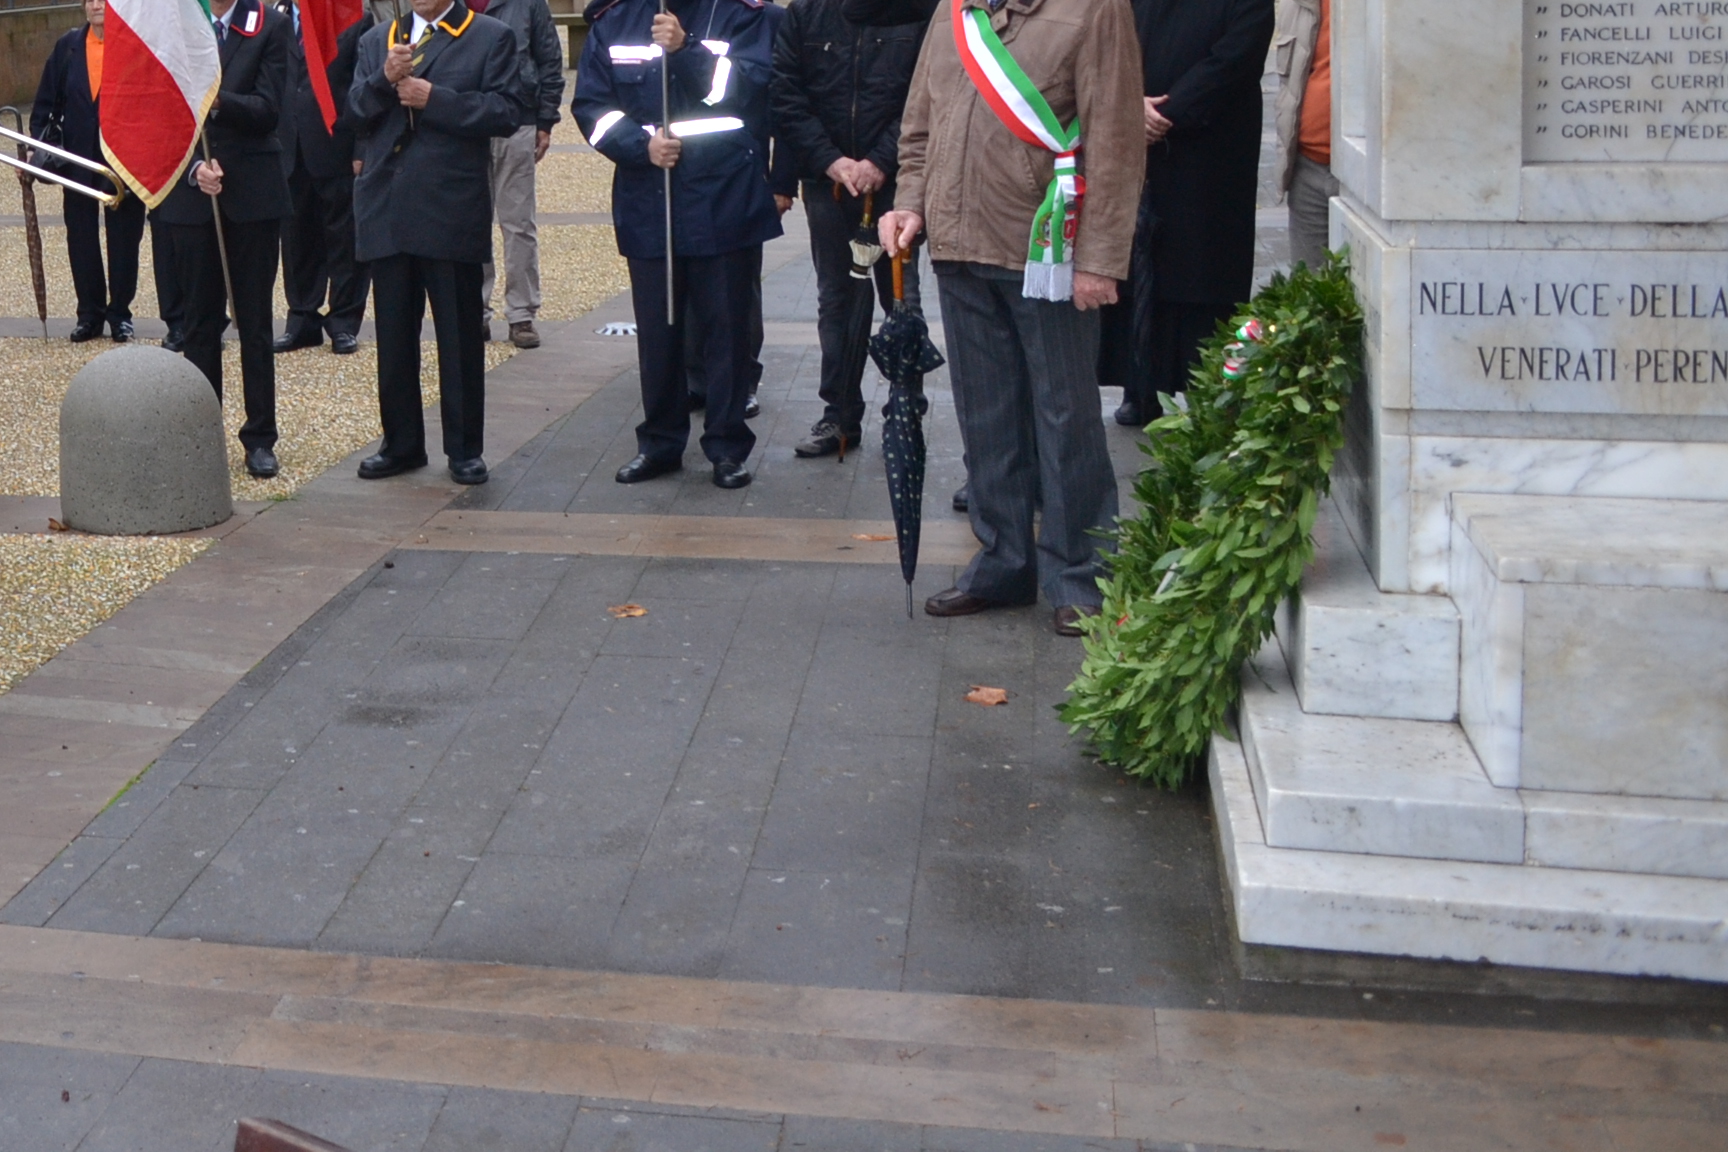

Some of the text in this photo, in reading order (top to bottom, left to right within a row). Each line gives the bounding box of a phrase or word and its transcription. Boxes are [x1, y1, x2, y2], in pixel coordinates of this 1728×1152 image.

[1561, 3, 1634, 18] DONATI
[1561, 27, 1650, 41] FANCELLI
[1669, 26, 1721, 40] LUIGI
[1561, 51, 1672, 65] FIORENZANI
[1561, 76, 1631, 90] GAROSI
[1562, 99, 1662, 114] GASPERINI
[1562, 124, 1628, 138] GORINI
[1419, 282, 1728, 318] NELLA LVCE DELLA
[1477, 347, 1728, 383] VENERATI PEREN
